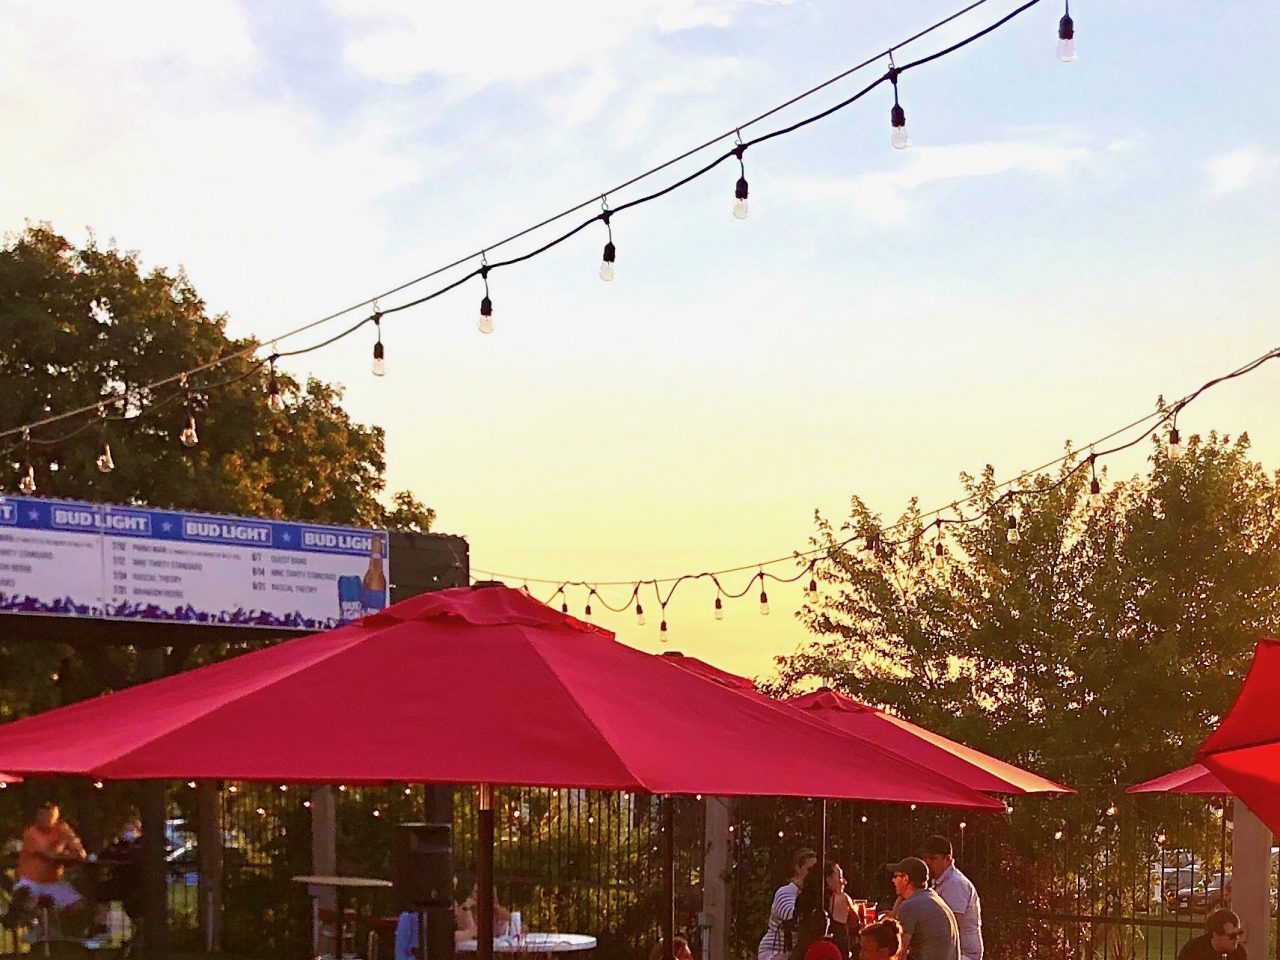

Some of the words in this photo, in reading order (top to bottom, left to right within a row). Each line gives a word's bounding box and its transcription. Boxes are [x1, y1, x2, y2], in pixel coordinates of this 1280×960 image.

[54, 509, 94, 526] BUD
[95, 513, 147, 531] LIGHT
[186, 521, 219, 536] BUD
[222, 525, 268, 542] LIGHT
[304, 532, 336, 547] BUD
[338, 535, 383, 551] LIGH
